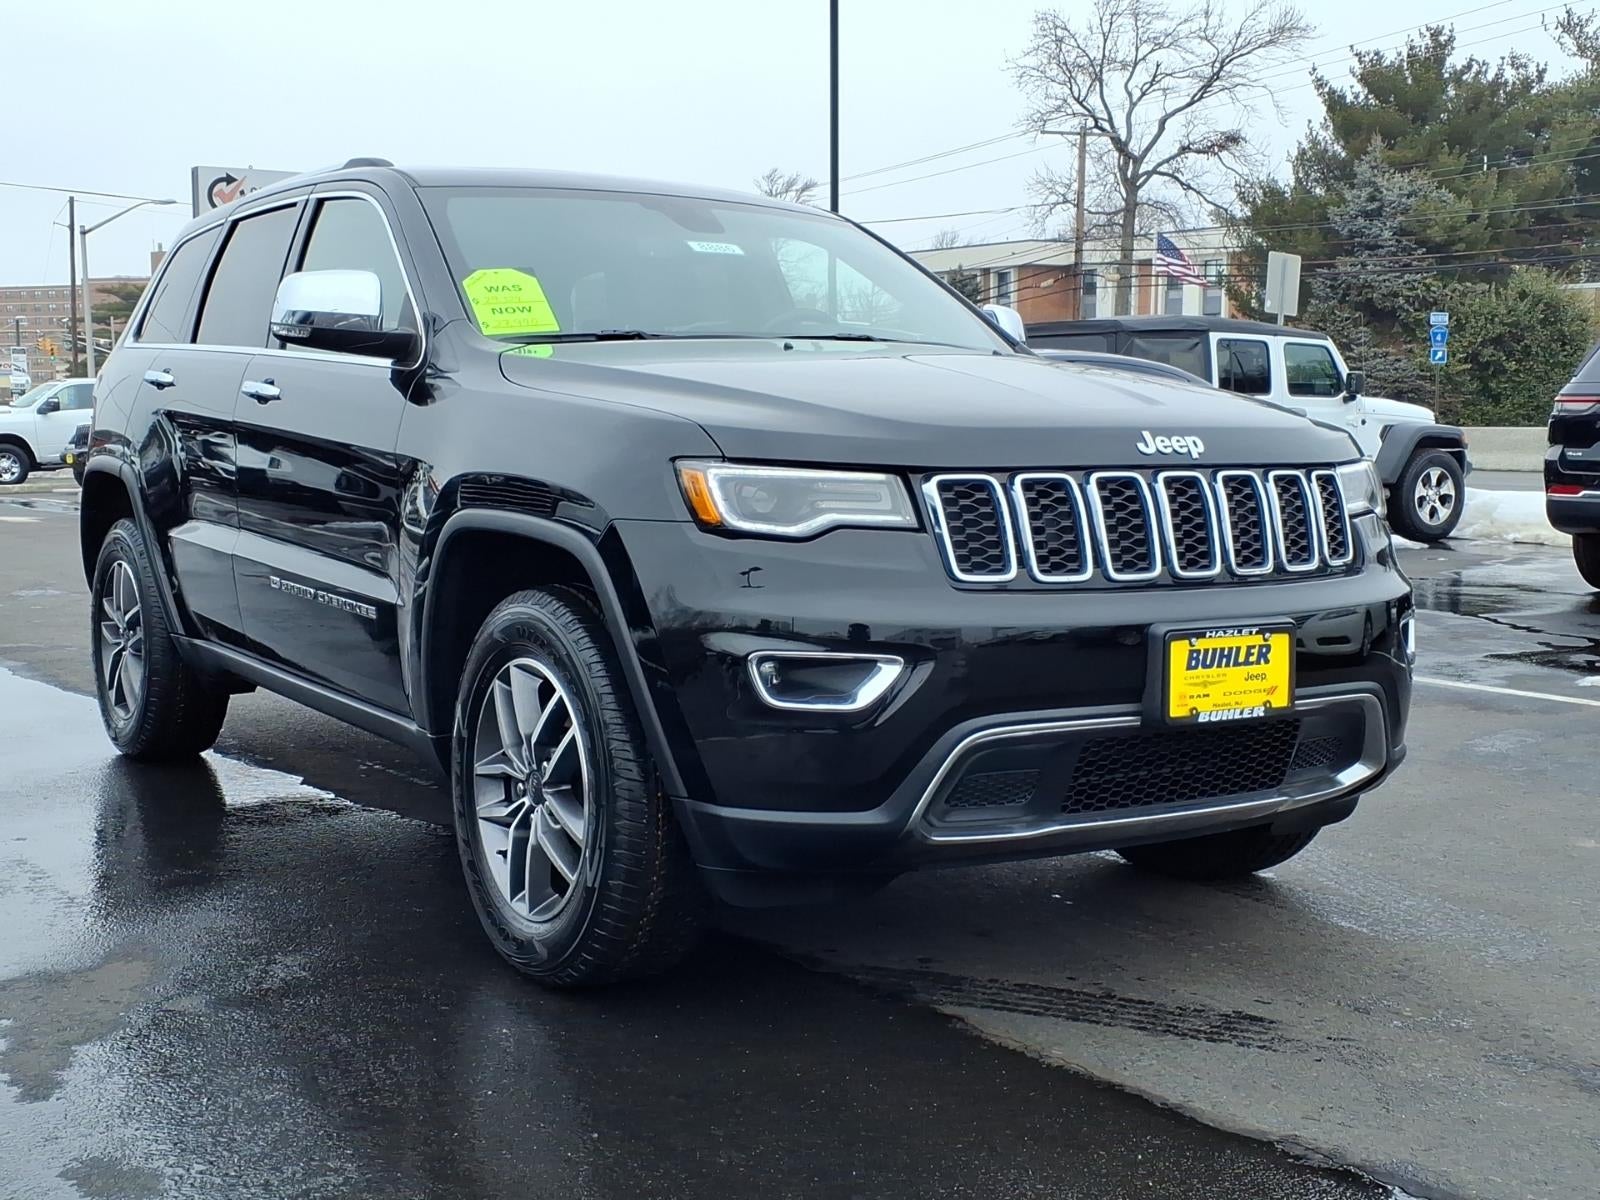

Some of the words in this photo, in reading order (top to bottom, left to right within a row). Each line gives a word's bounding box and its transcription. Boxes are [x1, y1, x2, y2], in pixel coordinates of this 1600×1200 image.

[484, 284, 523, 293] WAS
[491, 306, 532, 315] NOW
[1136, 430, 1205, 460] Jeep
[1206, 628, 1259, 638] HAZLET
[1186, 644, 1272, 671] BUHLER
[1184, 673, 1228, 681] CHRYSLER
[1244, 672, 1267, 682] Jeep
[1223, 688, 1269, 697] DODGE
[1198, 707, 1265, 722] BUHLER
